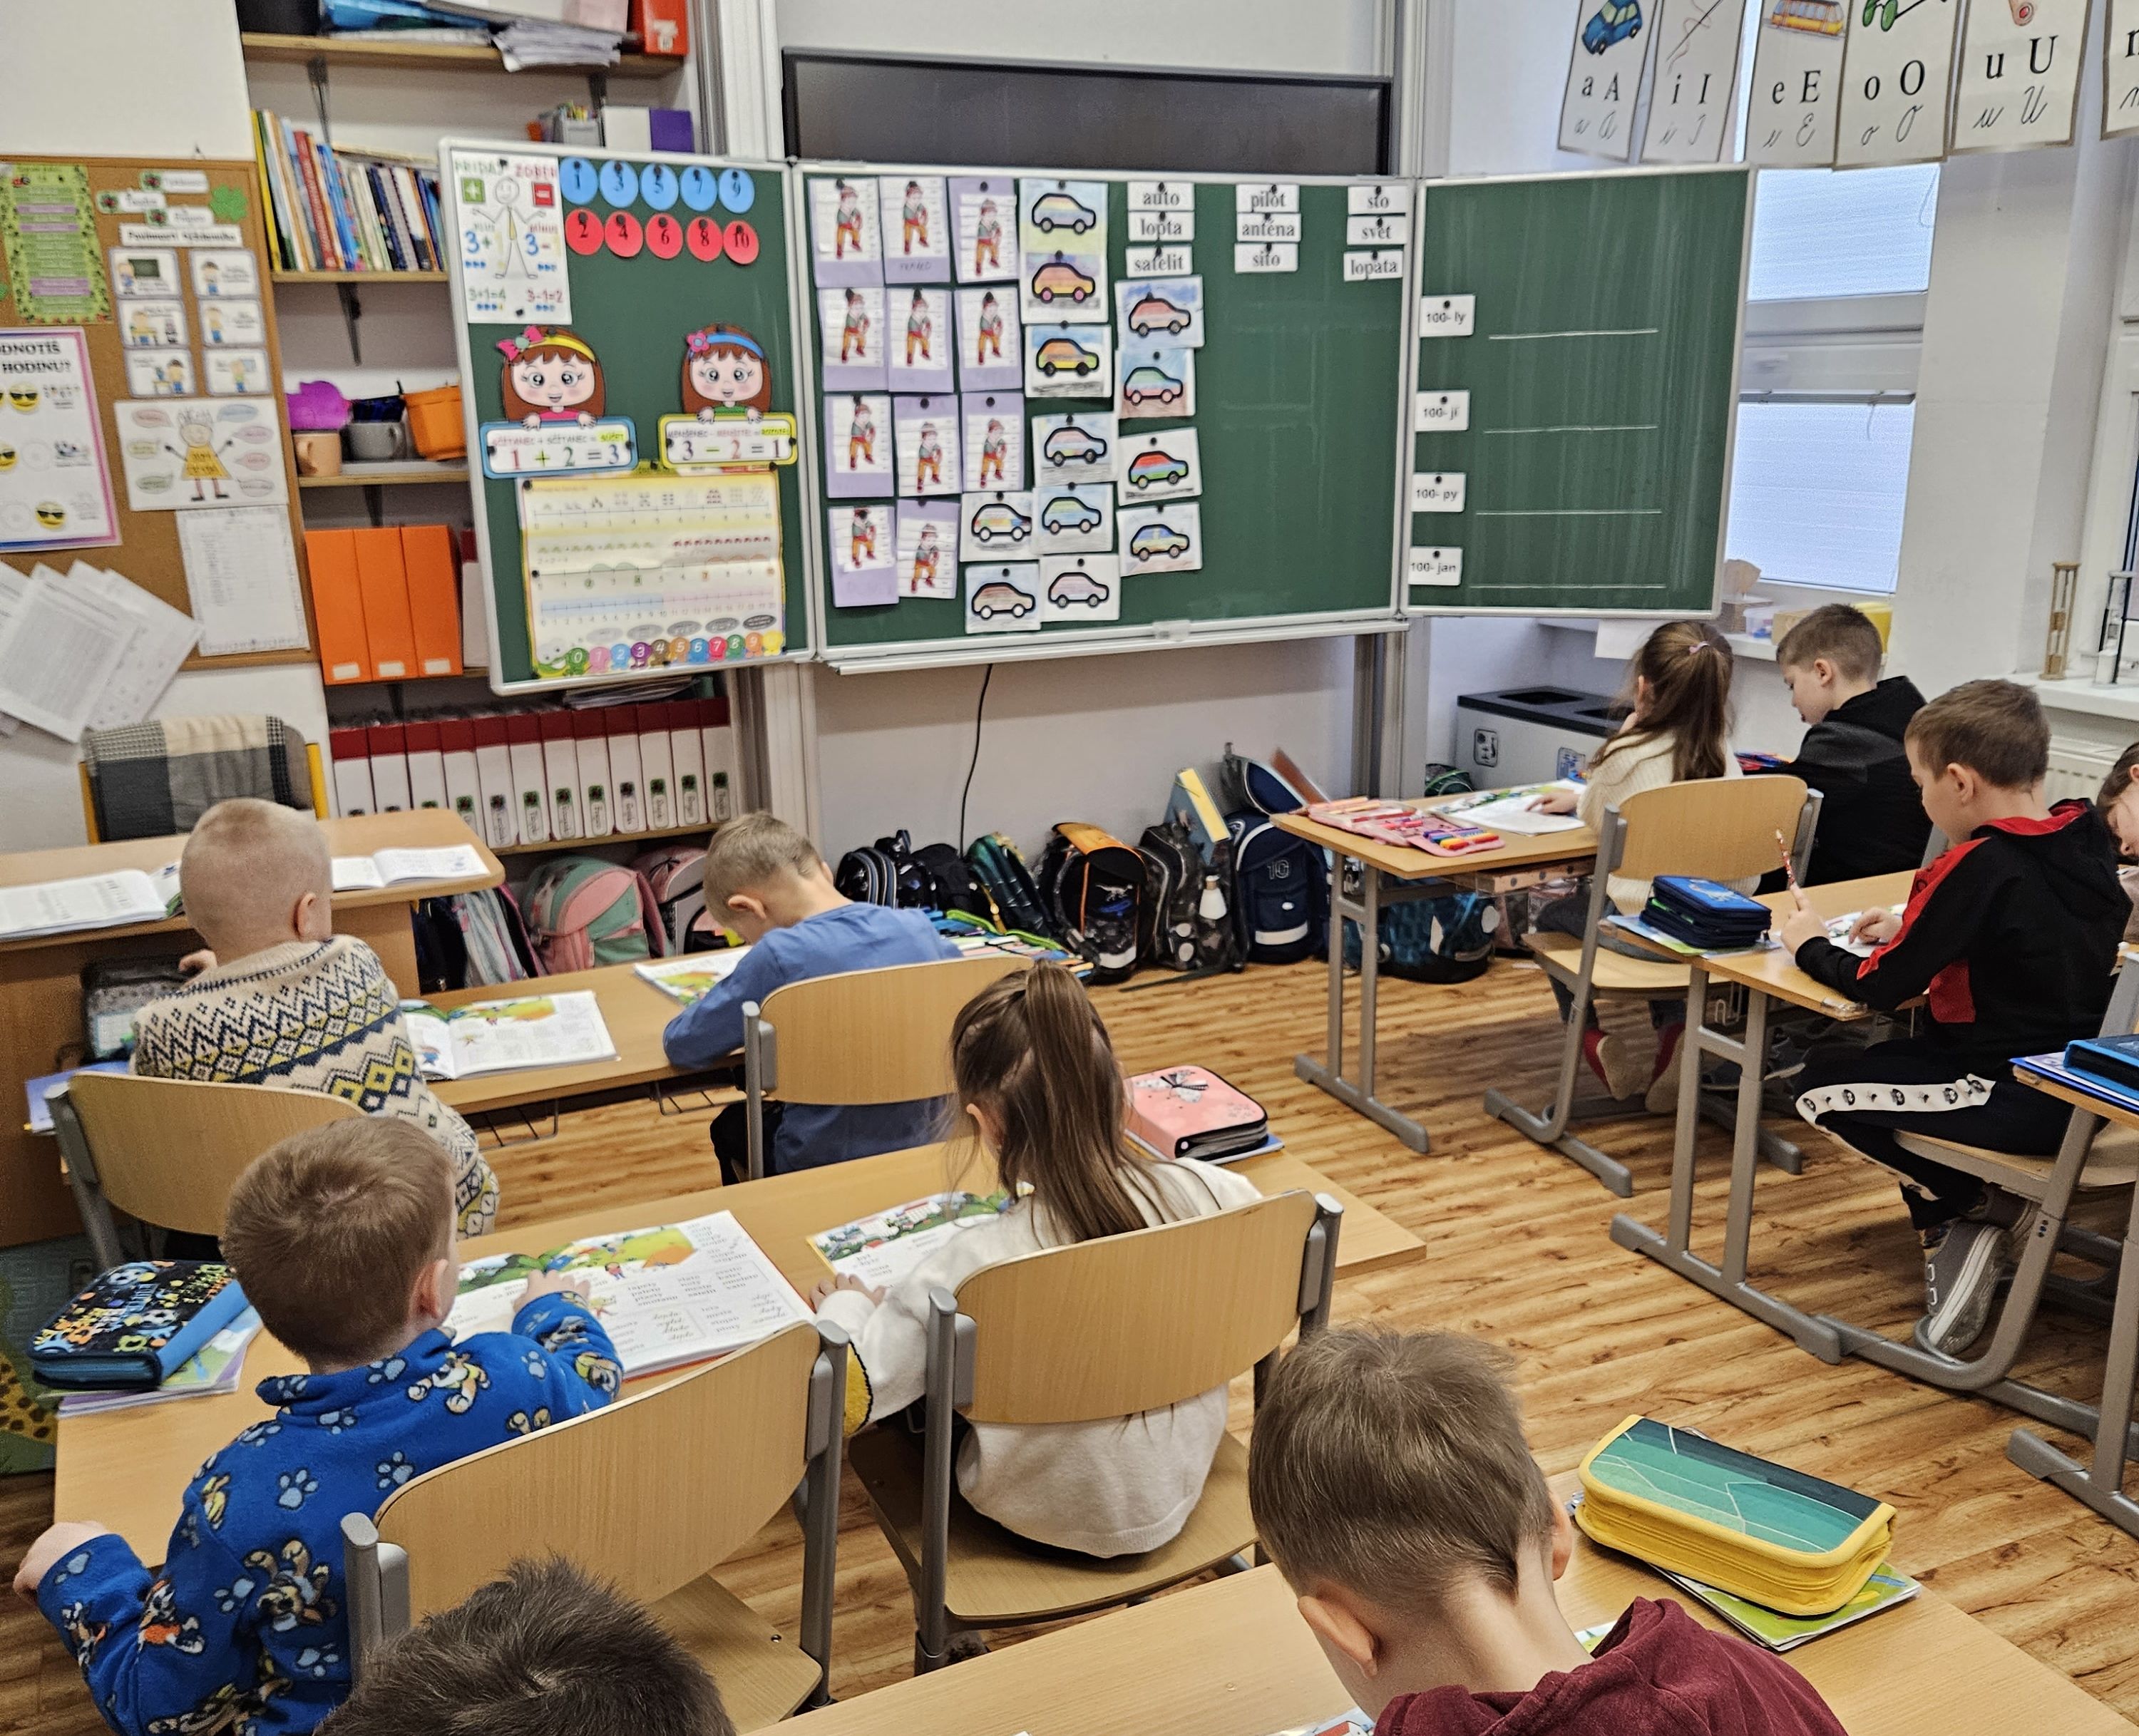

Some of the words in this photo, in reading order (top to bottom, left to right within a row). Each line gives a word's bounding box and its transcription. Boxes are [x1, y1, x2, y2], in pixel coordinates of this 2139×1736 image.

[1986, 53, 2005, 79] u
[2029, 35, 2059, 74] U
[1581, 76, 1593, 98] a
[1604, 72, 1620, 101] A
[1671, 74, 1682, 105] i
[1698, 73, 1713, 105] I
[1772, 81, 1785, 105] e
[1800, 71, 1821, 104] E
[1864, 76, 1880, 100] o
[1899, 59, 1925, 96] O
[575, 170, 581, 190] 1
[614, 172, 625, 191] 3
[654, 175, 665, 194] 5
[732, 180, 742, 198] 9
[1143, 190, 1181, 206] auto
[1251, 191, 1286, 213] pilot
[1367, 194, 1390, 210] sto
[579, 222, 589, 239] 2
[618, 224, 627, 240] 4
[661, 227, 671, 245] 6
[700, 228, 710, 246] 8
[1140, 218, 1183, 239] lopta
[1241, 218, 1295, 237] anténa
[1361, 224, 1392, 240] svet
[465, 230, 480, 253] 3
[525, 233, 538, 255] 3
[733, 231, 749, 249] 10
[1134, 254, 1184, 272] satelit
[1252, 250, 1281, 267] sito
[1350, 259, 1398, 280] lopata
[511, 448, 520, 470] 1
[563, 446, 575, 467] 2
[608, 444, 620, 465] 3
[682, 440, 694, 461] 3
[731, 439, 742, 460] 2
[772, 439, 780, 458] 1
[574, 652, 583, 662] 0
[617, 650, 625, 659] 2
[637, 647, 645, 657] 3
[656, 643, 665, 653] 4
[677, 643, 684, 652] 5
[694, 642, 702, 652] 6
[714, 641, 721, 652] 7
[731, 638, 739, 649] 8
